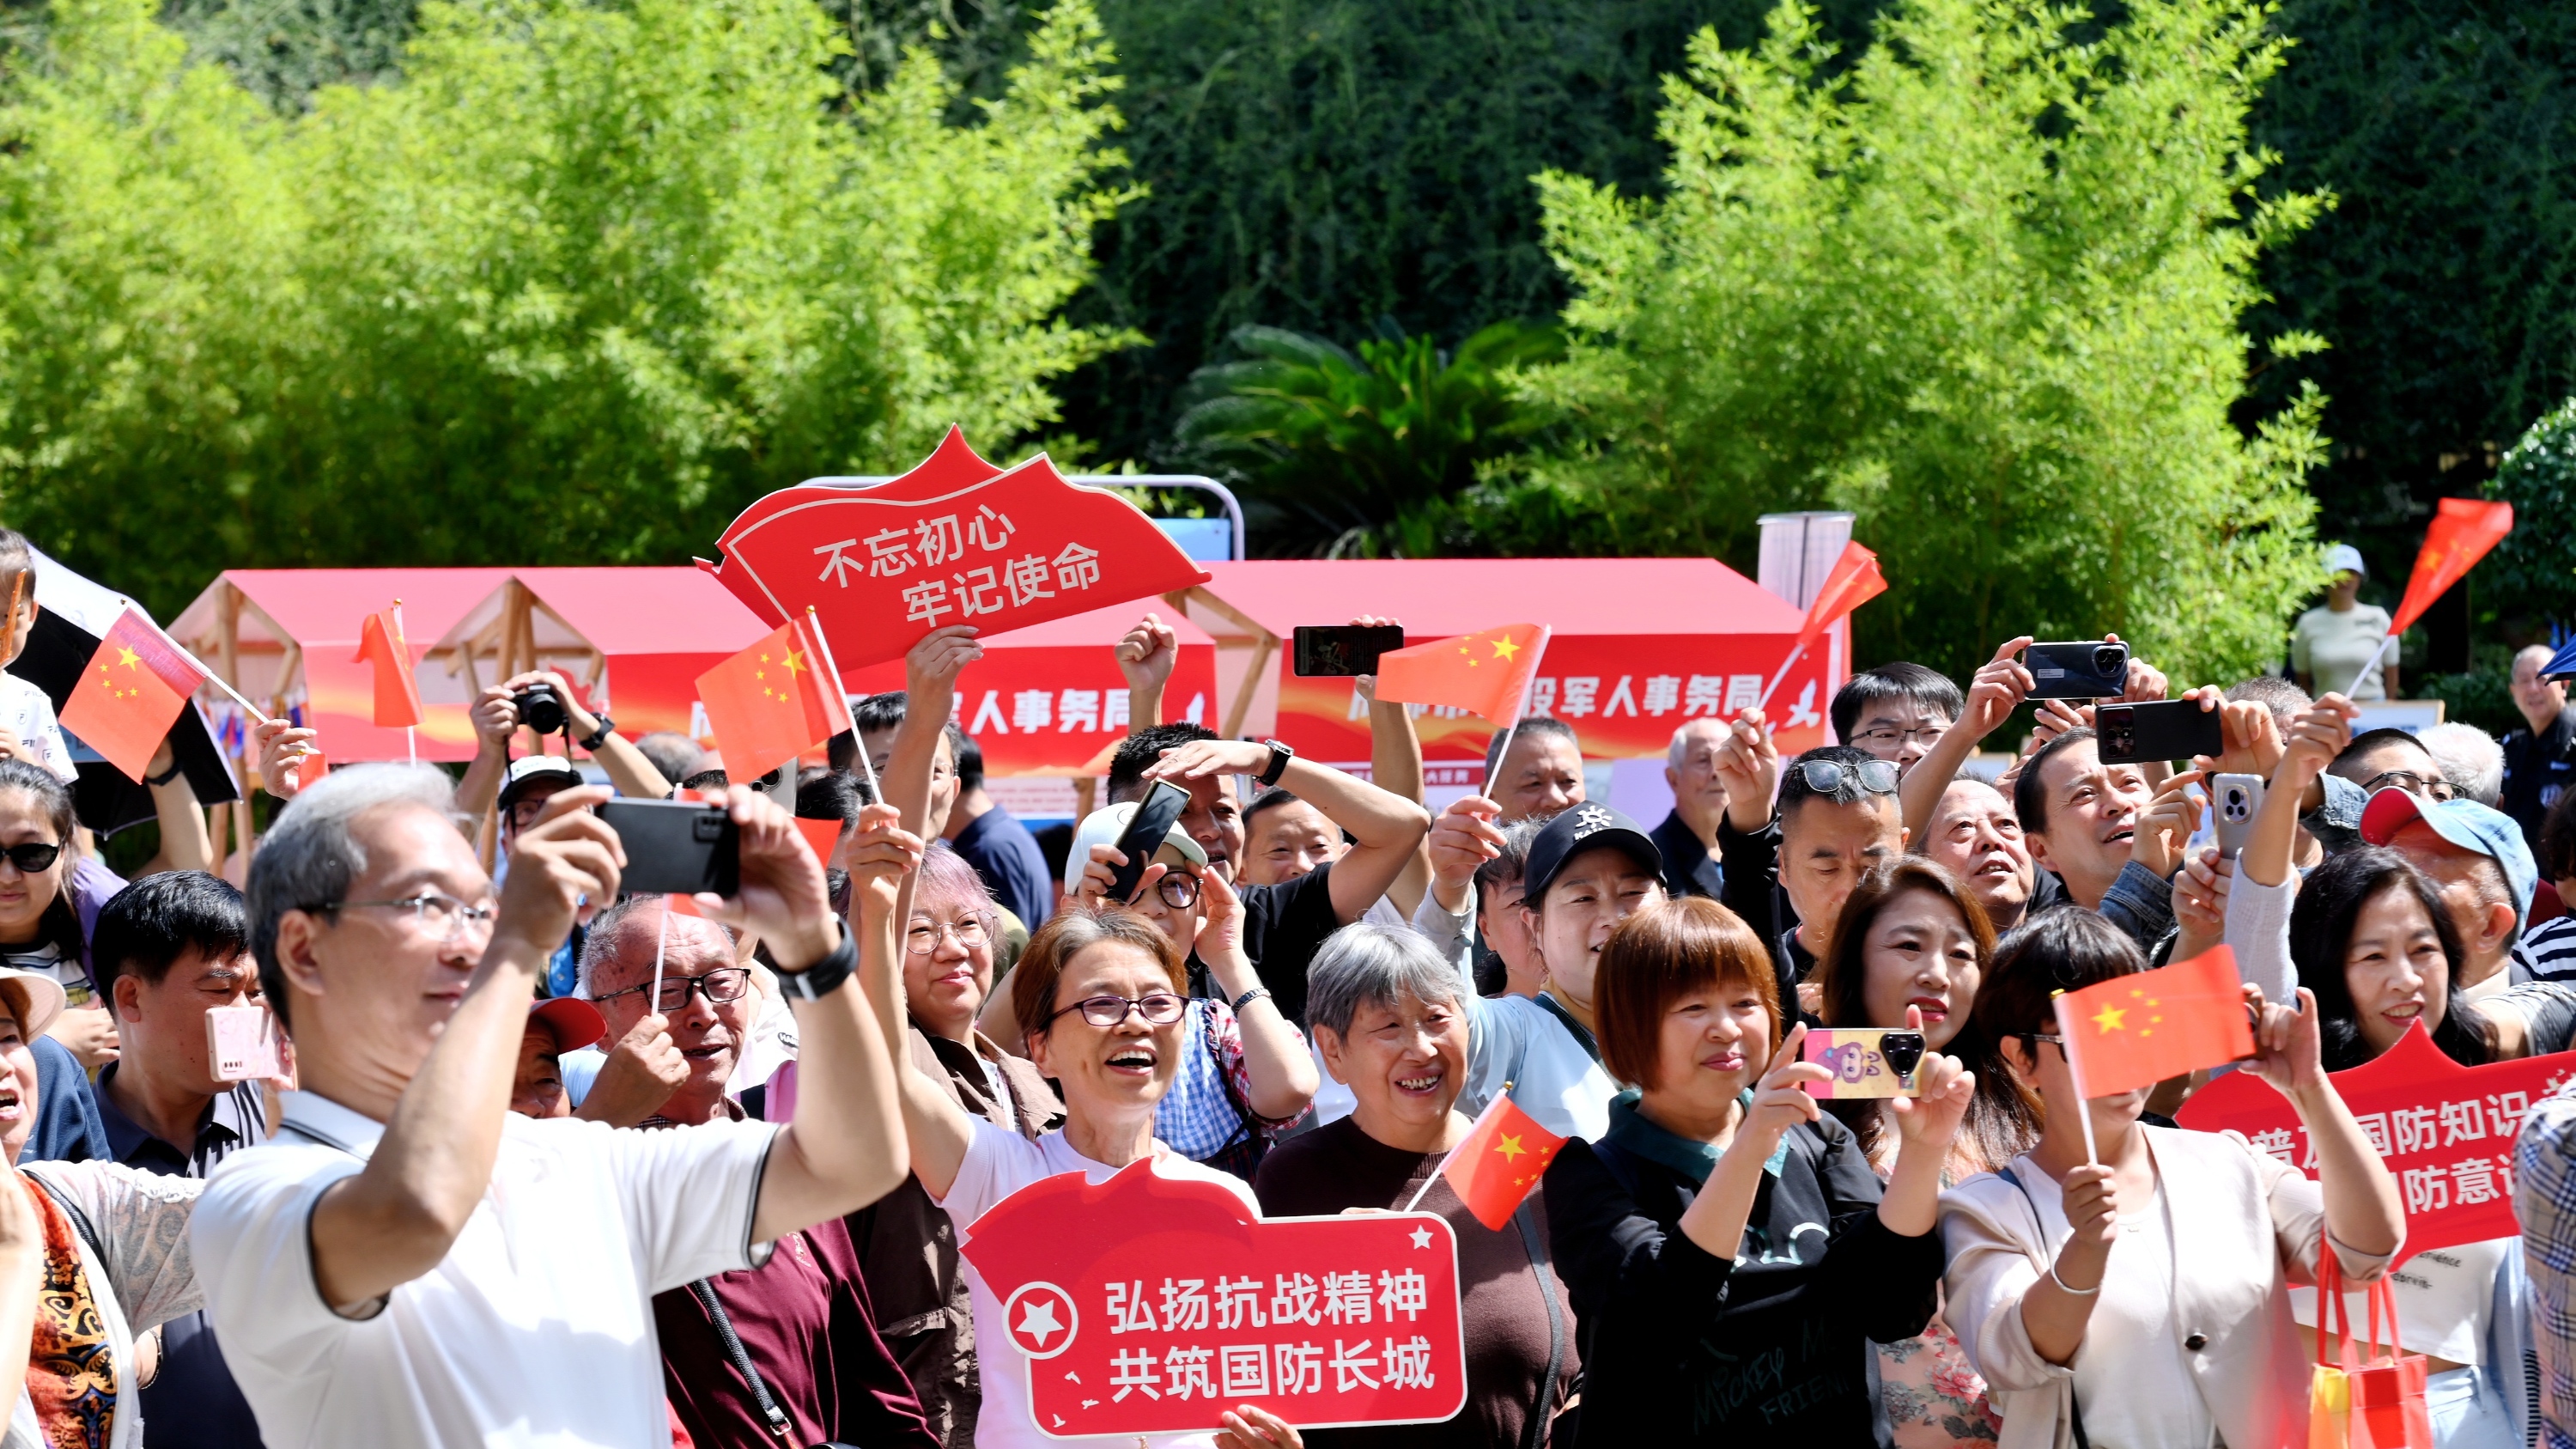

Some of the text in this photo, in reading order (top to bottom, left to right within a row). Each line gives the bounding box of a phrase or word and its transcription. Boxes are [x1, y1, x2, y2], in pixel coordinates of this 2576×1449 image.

[813, 503, 1017, 588] 不忘初心
[902, 542, 1101, 628] 牢记使命
[1104, 1267, 1427, 1335] 弘扬抗战精神
[1109, 1335, 1436, 1404] 共筑国防长城
[1759, 1371, 1850, 1426] FRIEN
